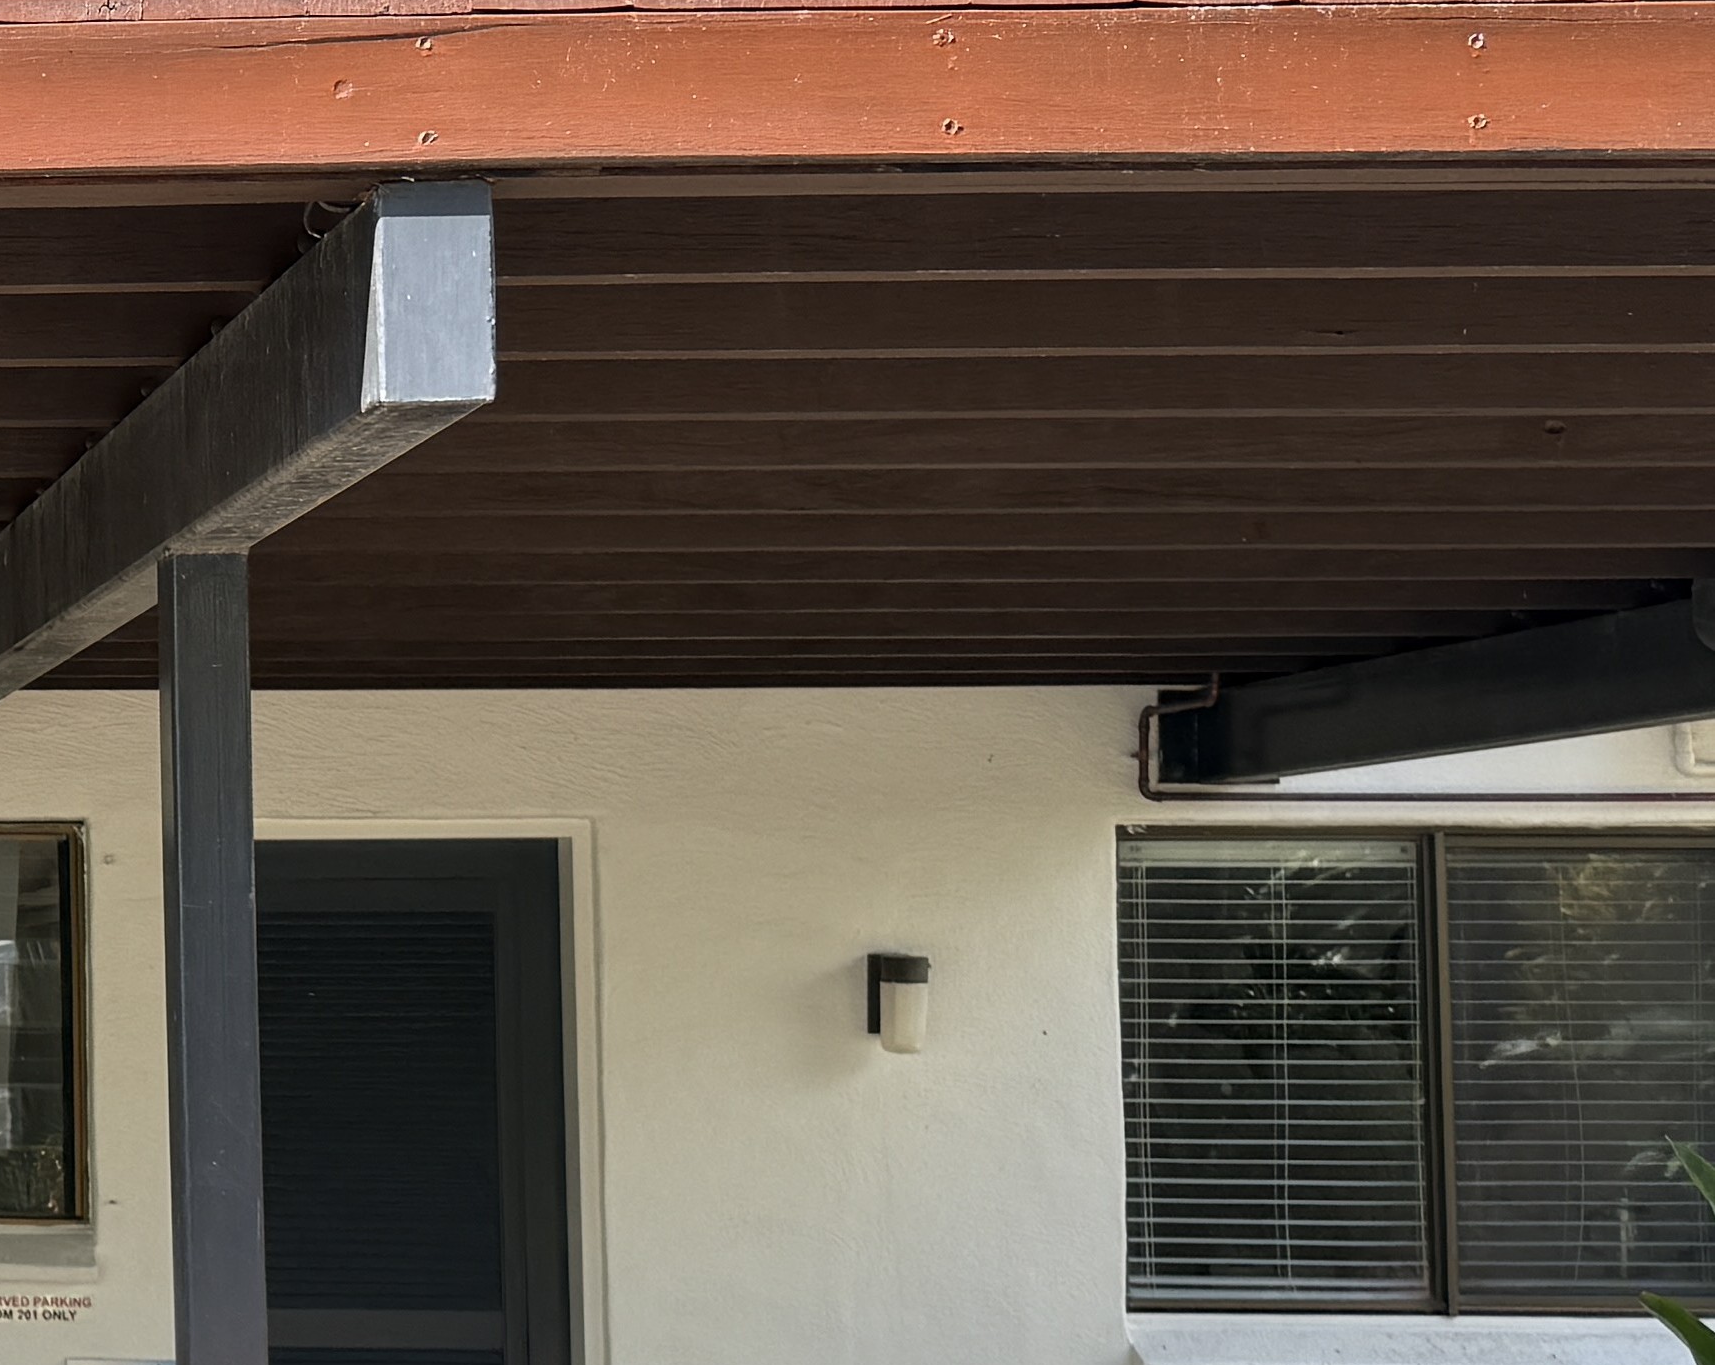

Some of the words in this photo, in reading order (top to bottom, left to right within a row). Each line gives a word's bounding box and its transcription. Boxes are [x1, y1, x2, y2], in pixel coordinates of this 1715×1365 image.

[32, 1296, 92, 1308] PARKING
[17, 1309, 38, 1321] 201
[41, 1309, 77, 1321] ONLY
